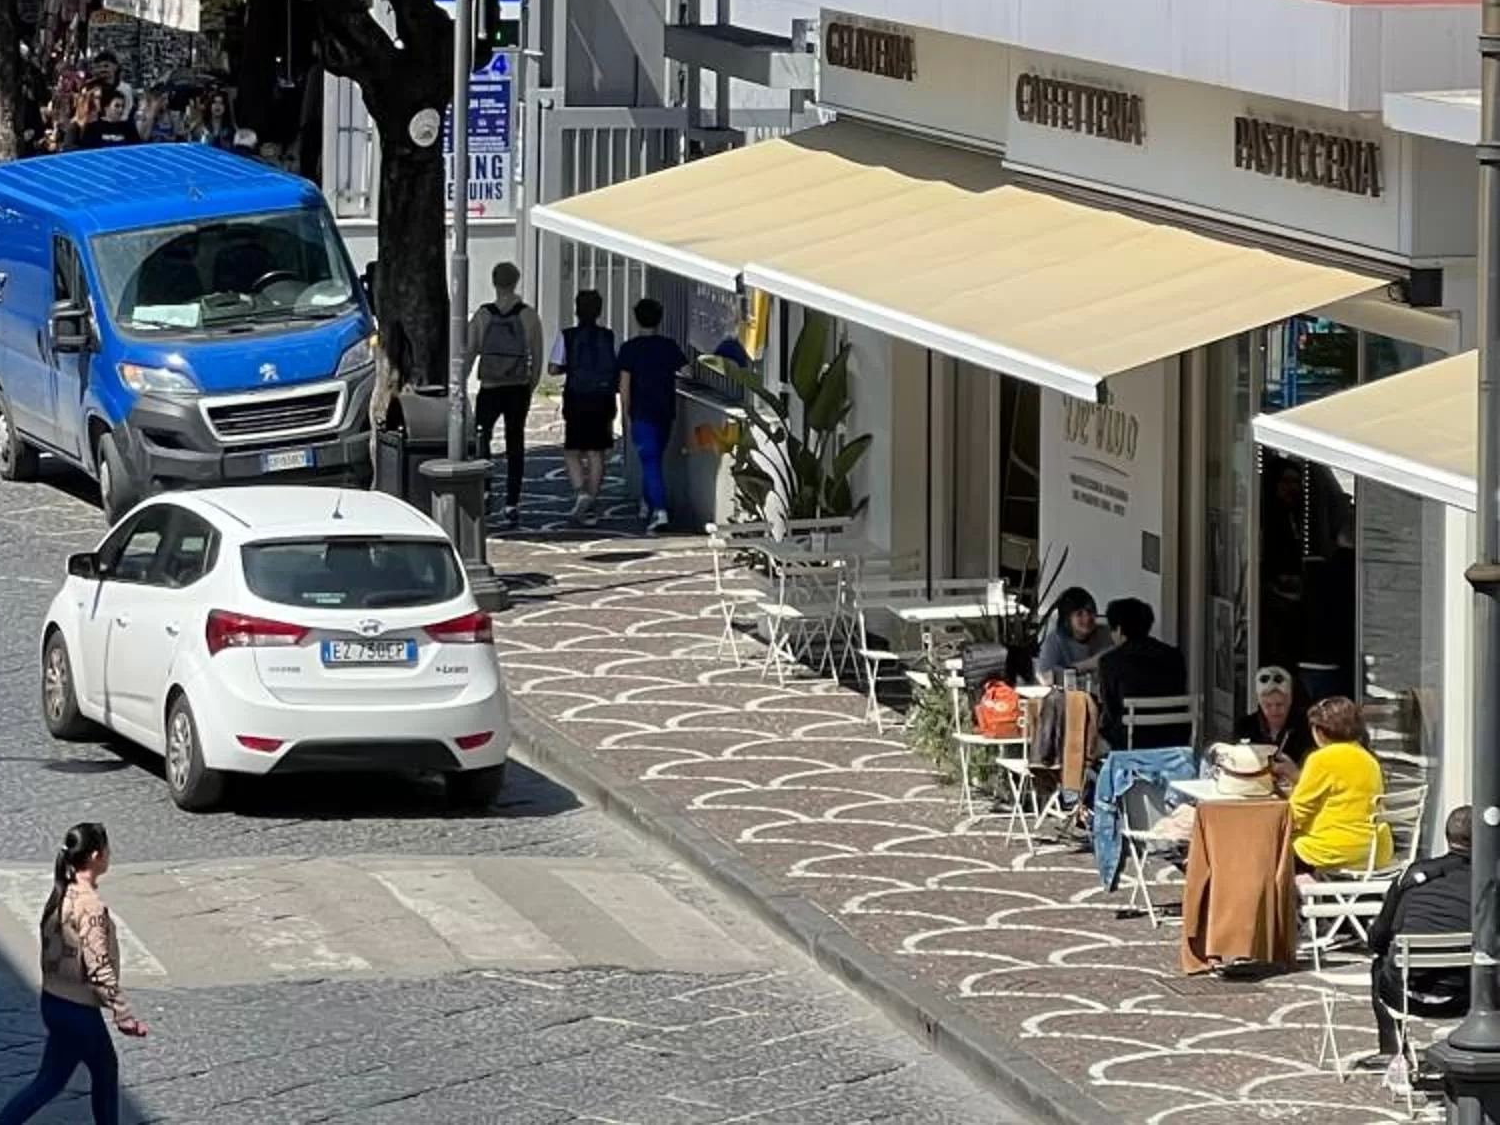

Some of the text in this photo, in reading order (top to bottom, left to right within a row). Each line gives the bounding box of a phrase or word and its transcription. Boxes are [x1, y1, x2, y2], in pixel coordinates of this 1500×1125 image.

[826, 22, 916, 81] GELATERIA
[1016, 73, 1145, 145] CAFFETTERIA
[1235, 117, 1384, 197] PASTICCERIA
